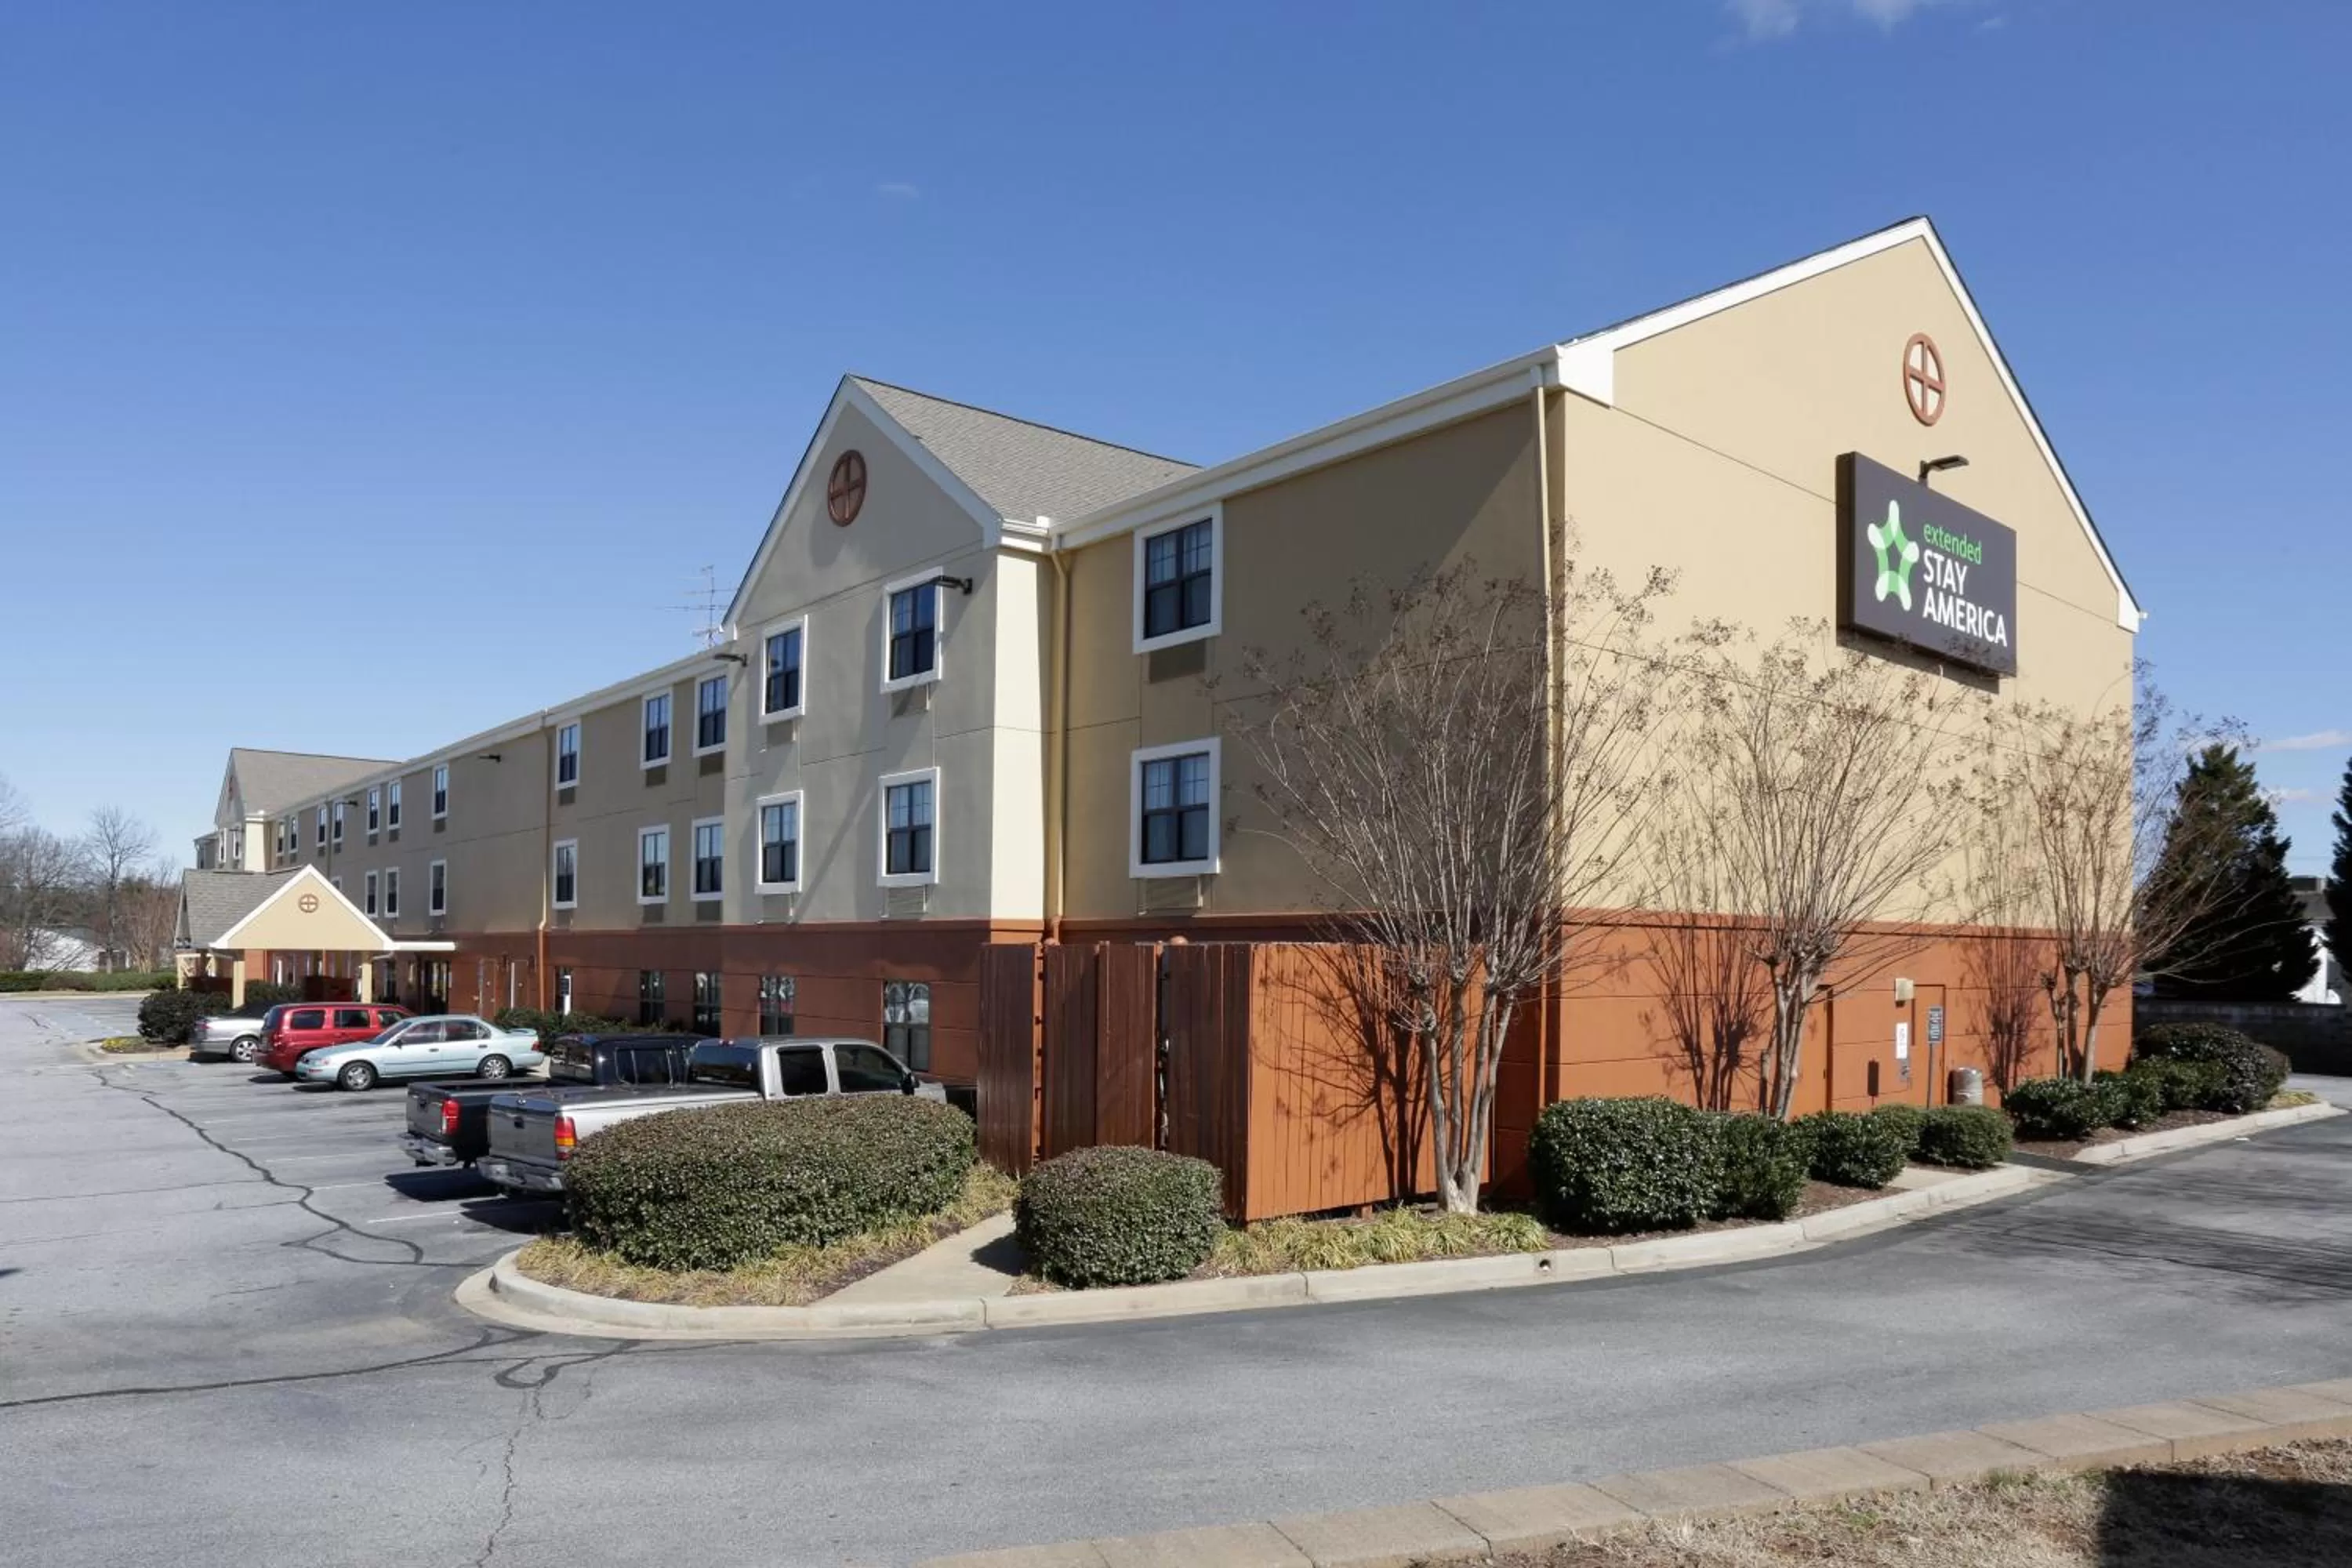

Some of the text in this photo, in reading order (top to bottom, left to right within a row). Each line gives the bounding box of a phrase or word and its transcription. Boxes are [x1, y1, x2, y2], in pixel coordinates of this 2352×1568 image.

[1923, 524, 1982, 564] extended
[1923, 550, 1968, 595] STAY
[1922, 587, 2008, 647] AMERICA
